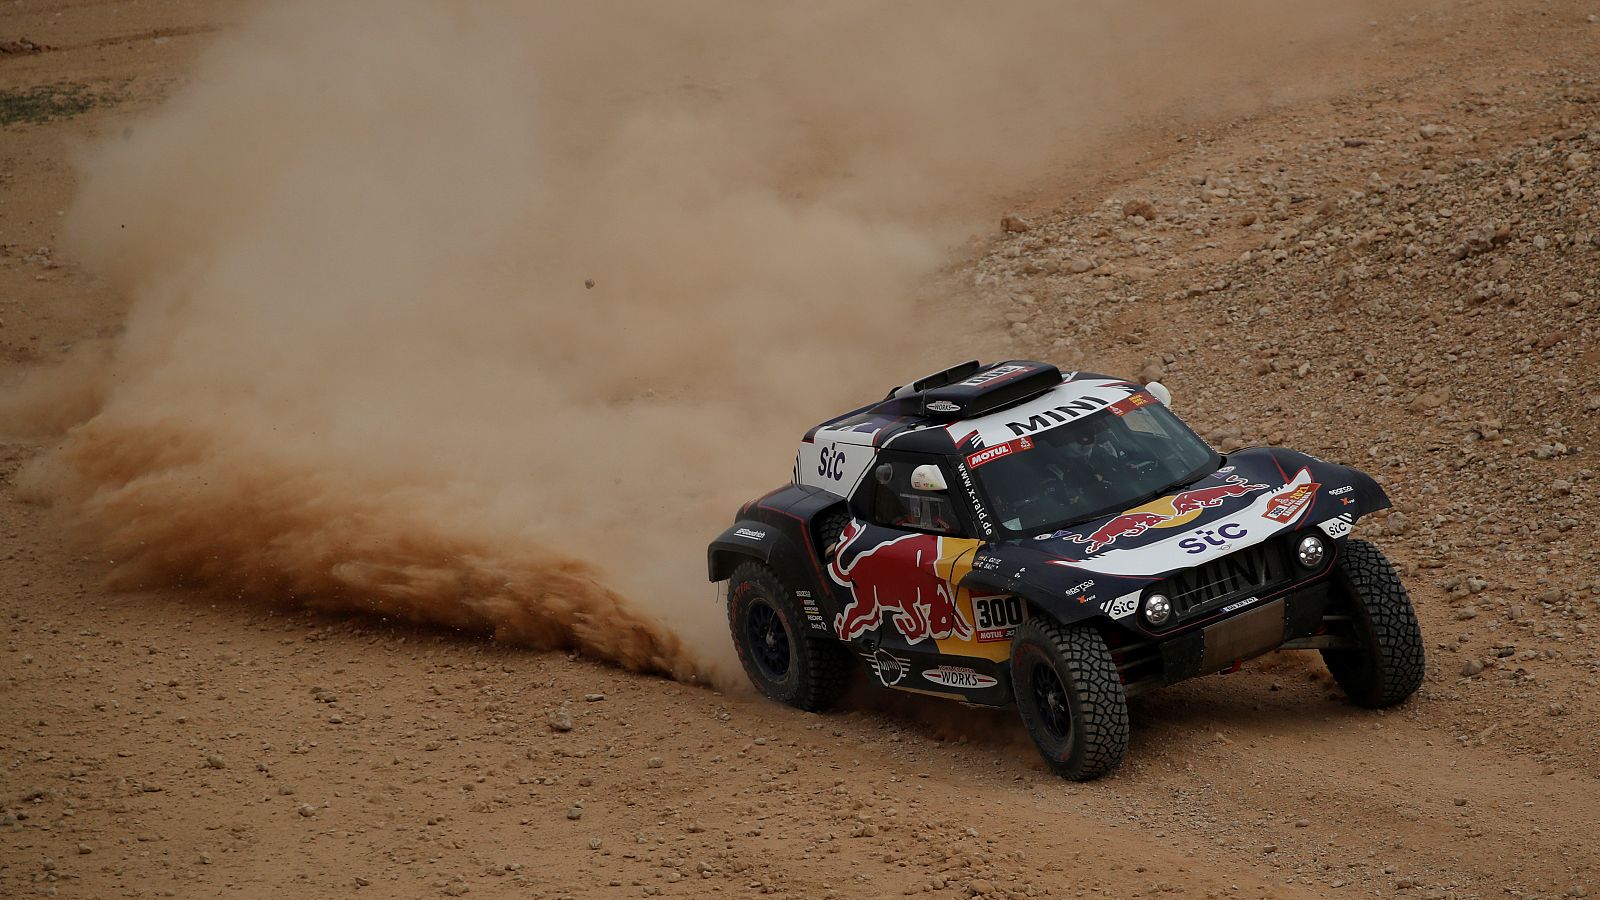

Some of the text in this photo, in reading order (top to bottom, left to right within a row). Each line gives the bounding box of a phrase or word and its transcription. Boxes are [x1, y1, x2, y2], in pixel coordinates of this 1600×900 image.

[1005, 395, 1109, 437] MINI
[971, 445, 1008, 465] MOTUL
[957, 462, 993, 536] www.x-raid.de
[1289, 485, 1310, 500] 2021
[1173, 546, 1273, 612] MINI
[976, 596, 1024, 629] 300
[980, 631, 1003, 640] MOTUL
[941, 671, 978, 686] WORKS
